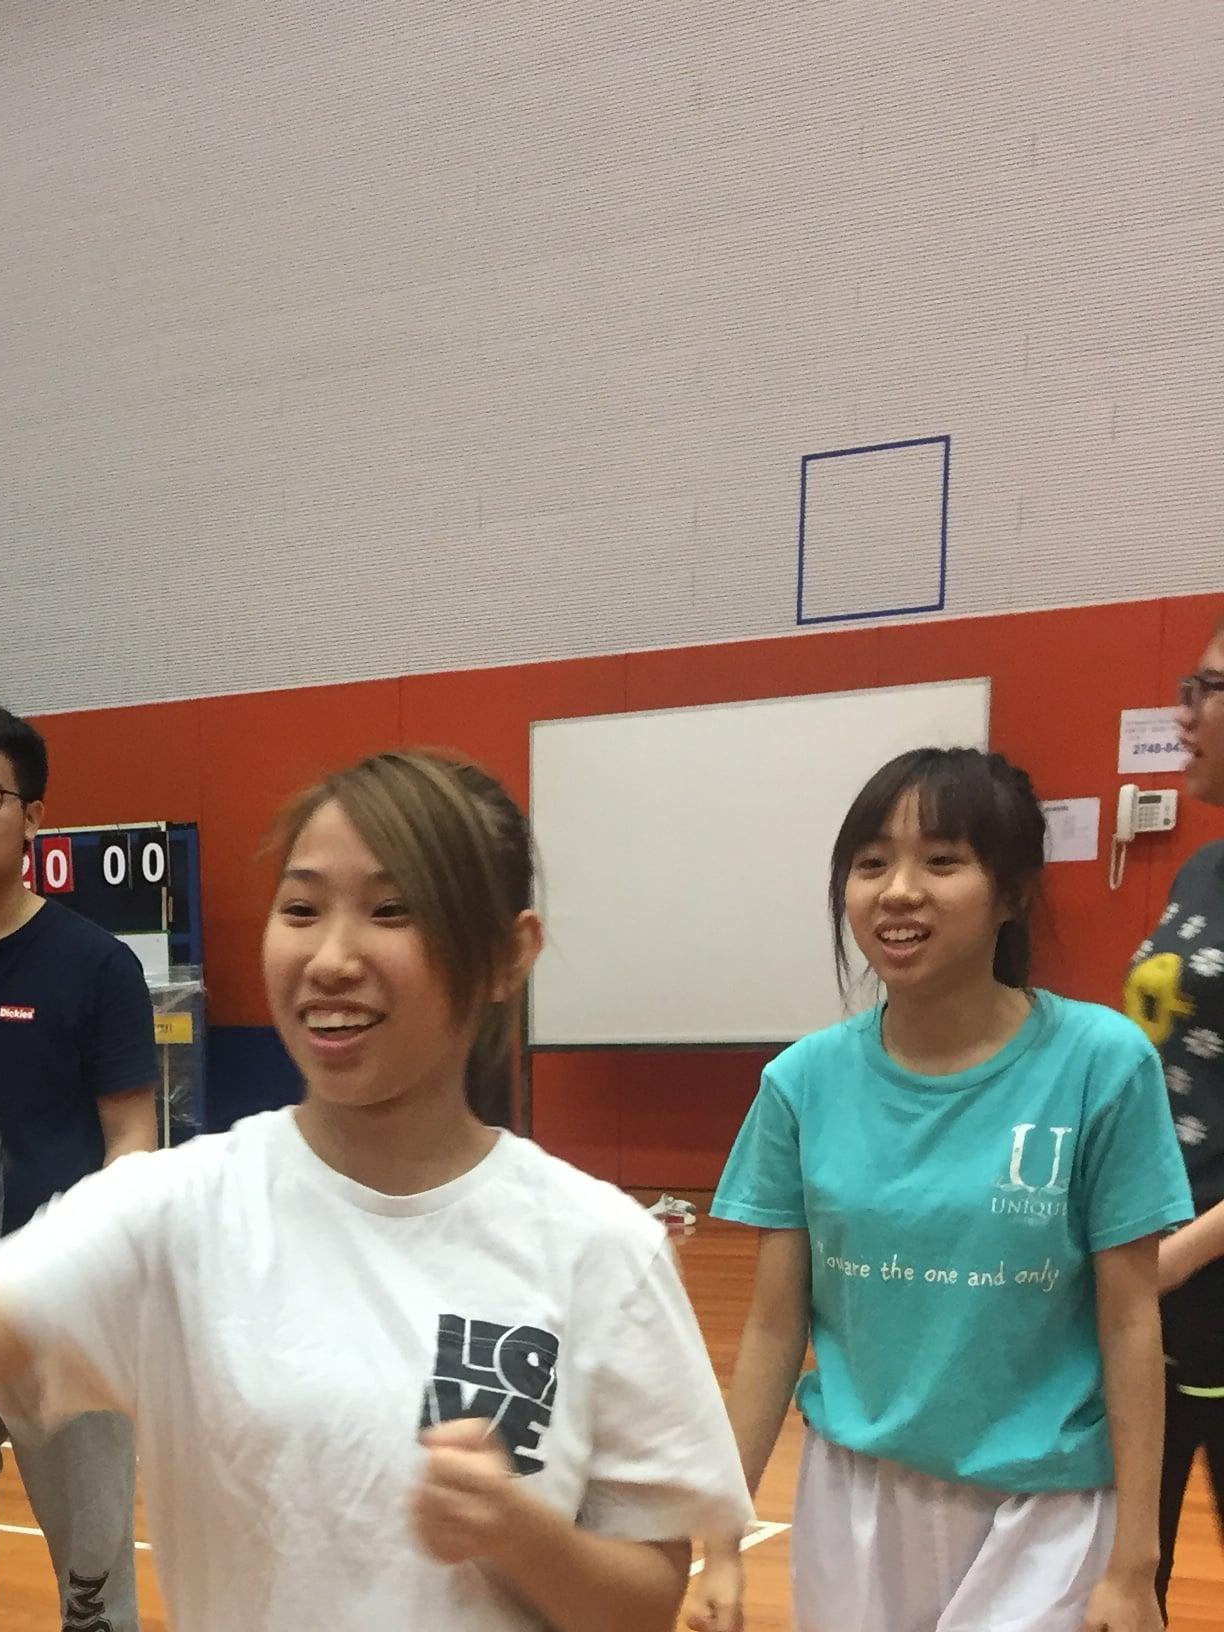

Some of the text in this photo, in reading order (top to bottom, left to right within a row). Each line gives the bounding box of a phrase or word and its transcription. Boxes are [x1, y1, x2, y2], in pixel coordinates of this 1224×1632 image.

[0, 1005, 35, 1019] Dickies
[1009, 1123, 1073, 1193] U
[880, 1254, 915, 1281] the
[924, 1269, 958, 1284] one
[967, 1261, 1007, 1287] and
[1014, 1258, 1060, 1293] only
